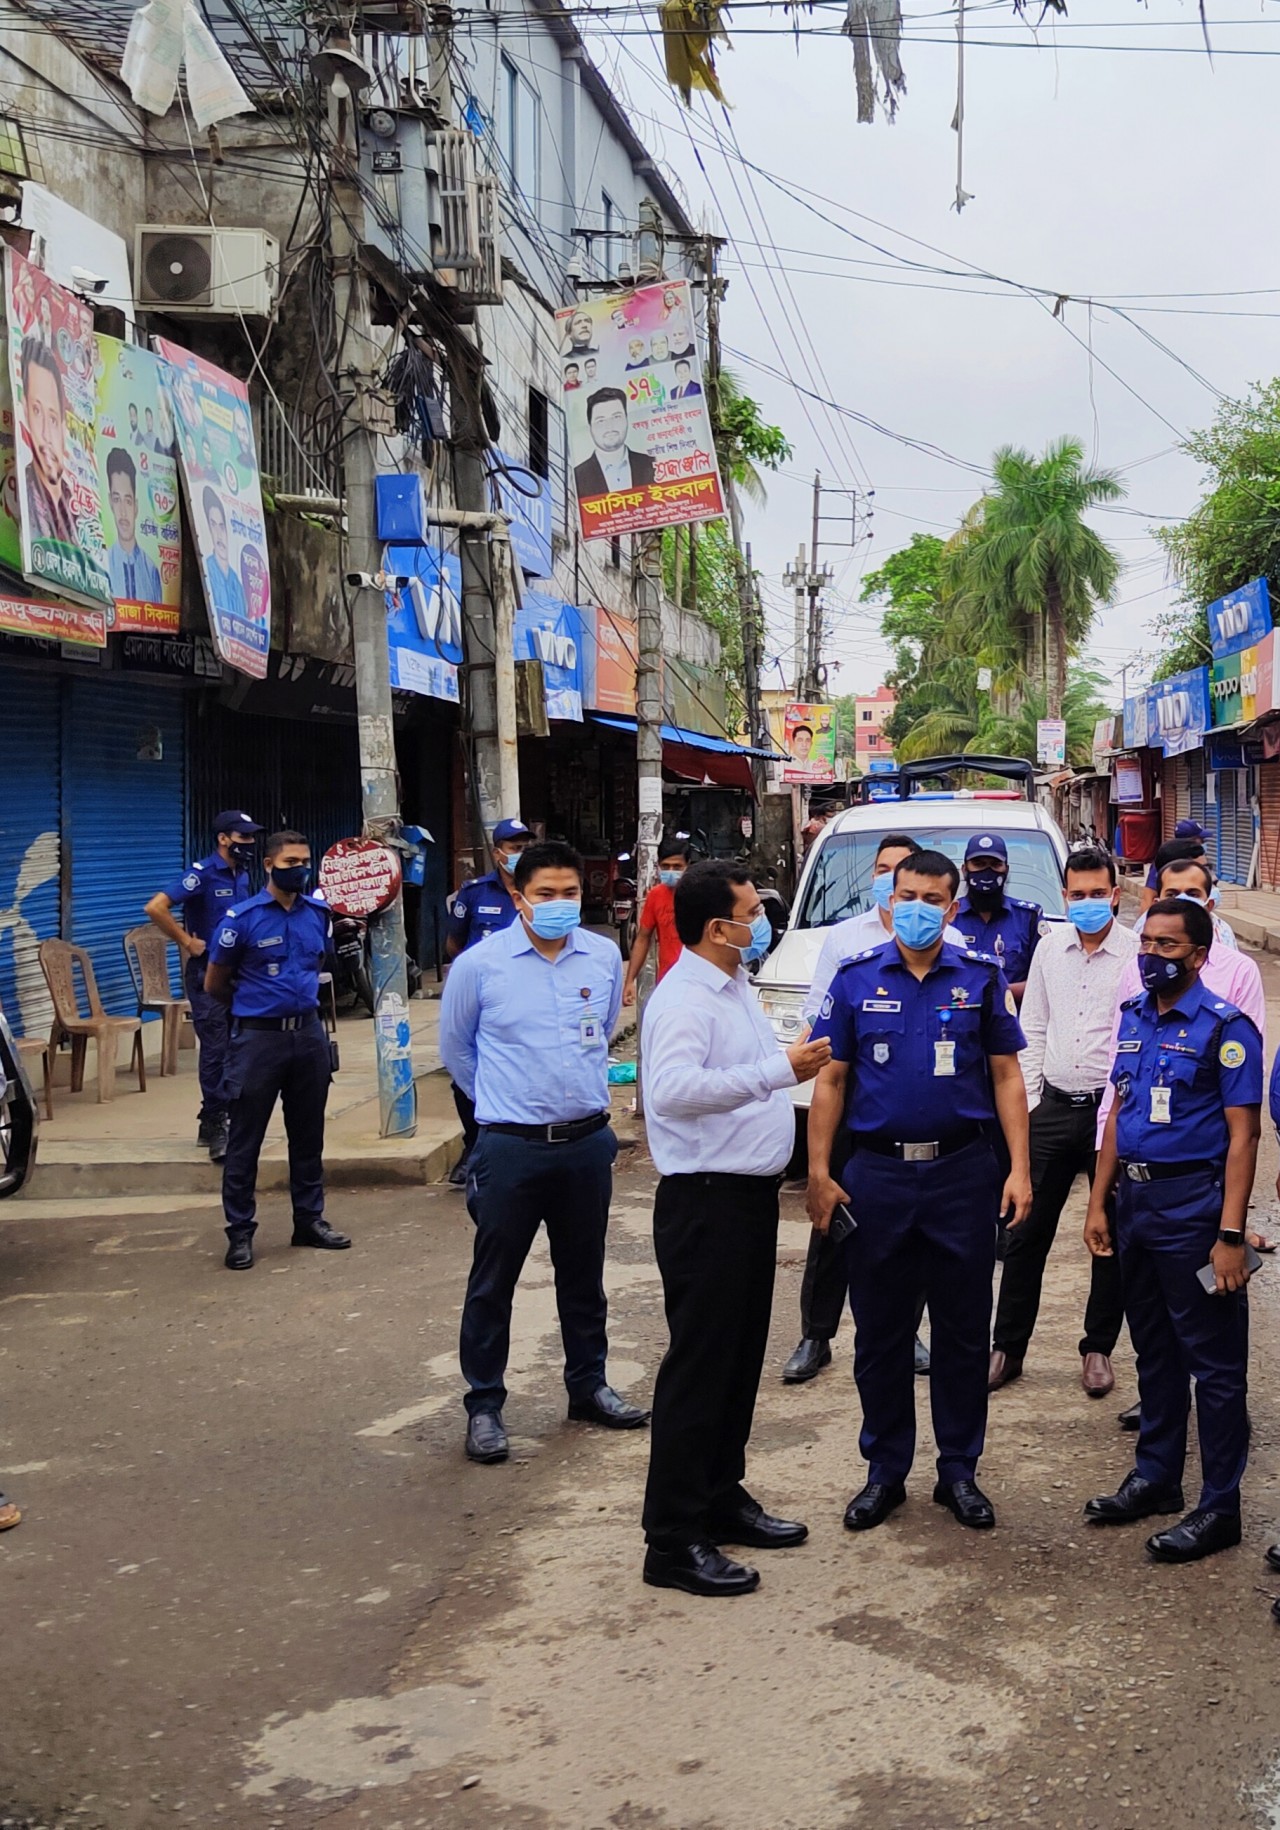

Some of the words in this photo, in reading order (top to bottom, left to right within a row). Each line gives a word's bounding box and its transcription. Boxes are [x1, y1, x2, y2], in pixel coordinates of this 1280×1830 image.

[627, 377, 652, 401] ১৭
[582, 493, 645, 515] আসিফ
[648, 478, 715, 503] ইকবাল
[117, 602, 141, 620] রাজা
[144, 602, 180, 625] সিকদার
[532, 620, 576, 670] vivo
[1214, 676, 1238, 702] oppo
